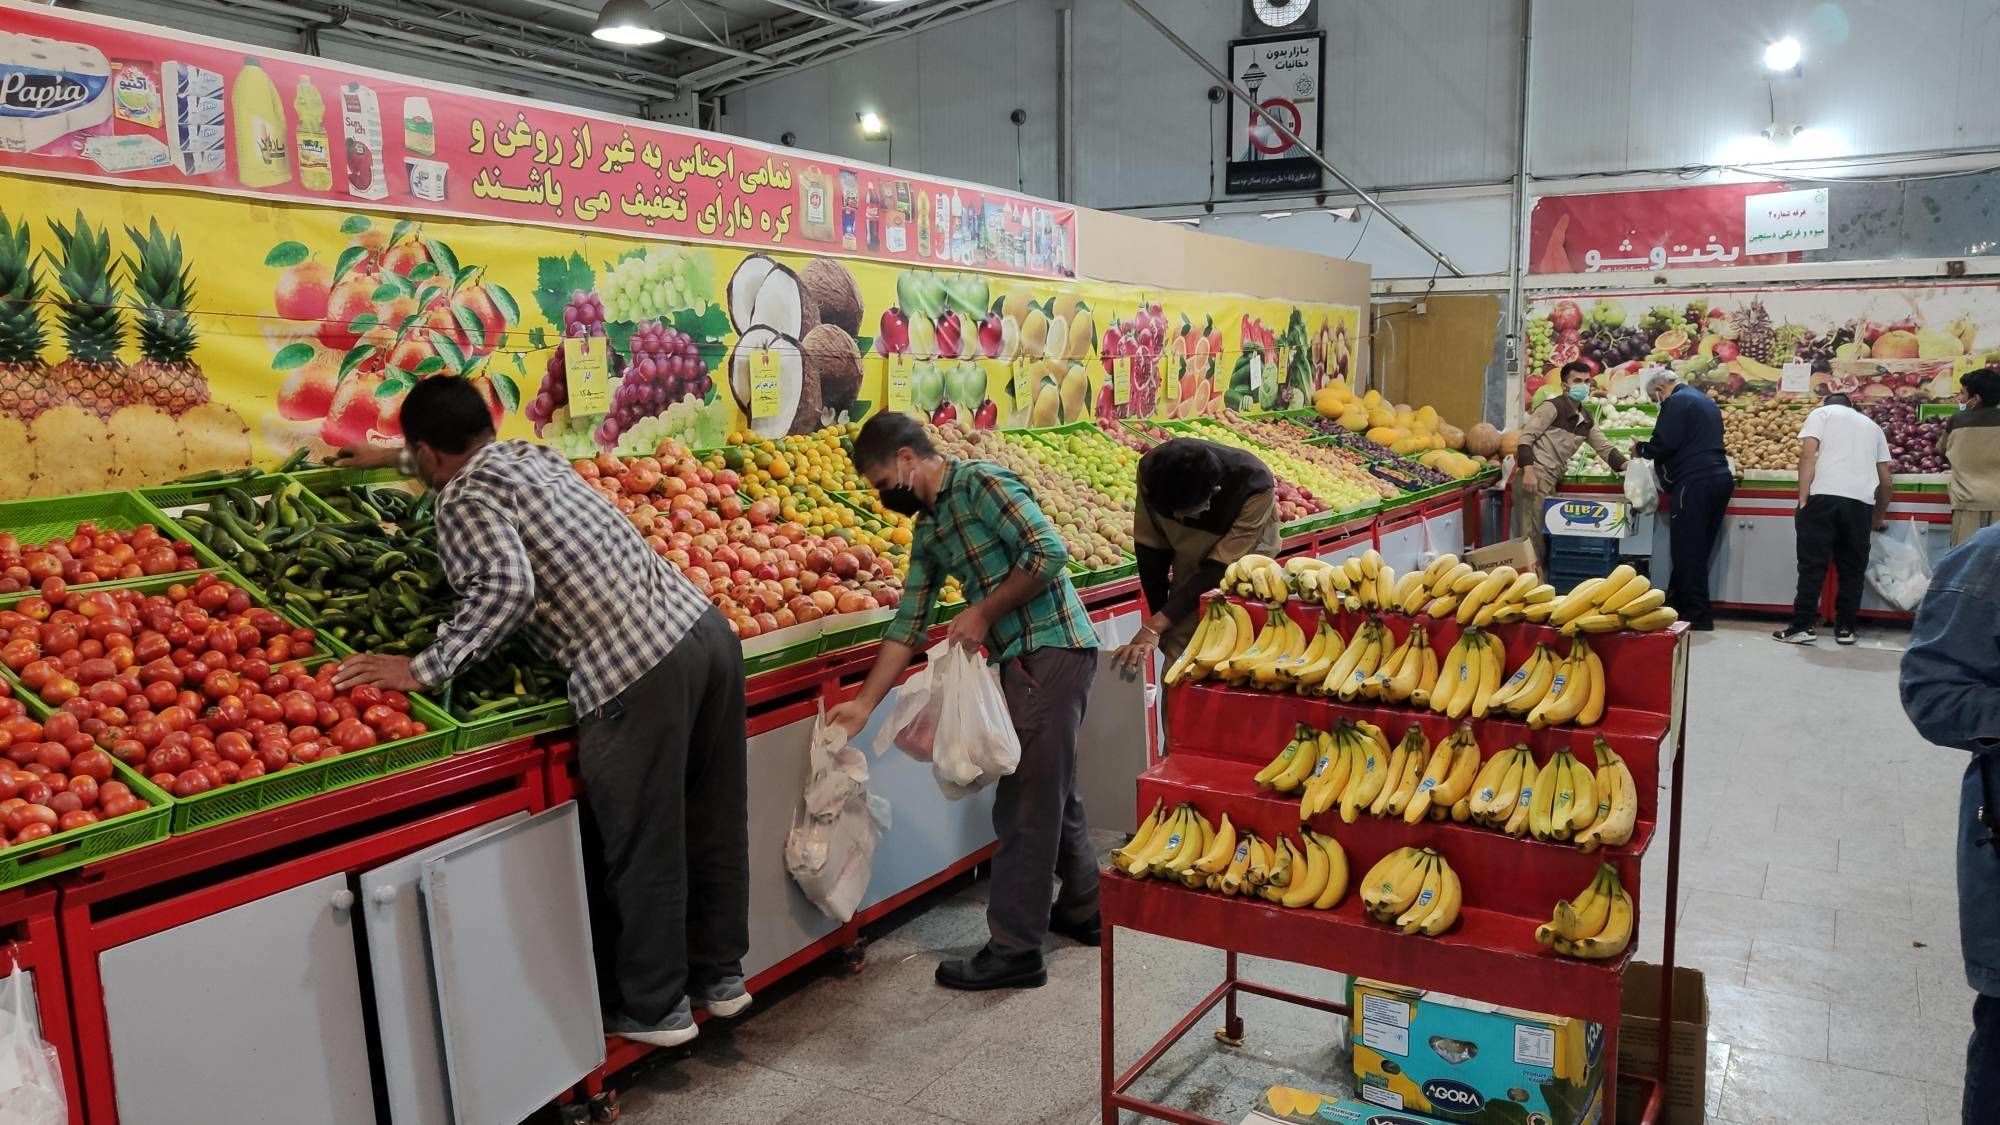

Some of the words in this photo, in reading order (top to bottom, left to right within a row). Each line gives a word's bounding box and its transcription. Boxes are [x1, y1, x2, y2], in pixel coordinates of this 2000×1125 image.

[1266, 50, 1287, 59] بدون
[1289, 46, 1309, 57] بازار
[2, 71, 86, 110] Papia
[469, 118, 486, 154] و
[493, 111, 564, 166] روغن
[569, 121, 593, 170] از
[599, 129, 636, 174] غیر
[641, 141, 662, 179] به
[668, 142, 735, 189] اجناس
[739, 155, 792, 194] تمامی
[472, 166, 563, 217] باشند
[574, 190, 611, 222] می
[620, 182, 688, 227] تخفیف
[696, 192, 753, 239] دارای
[760, 204, 792, 243] کره
[1564, 504, 1605, 518] Zain
[1426, 1084, 1480, 1107] AGORA
